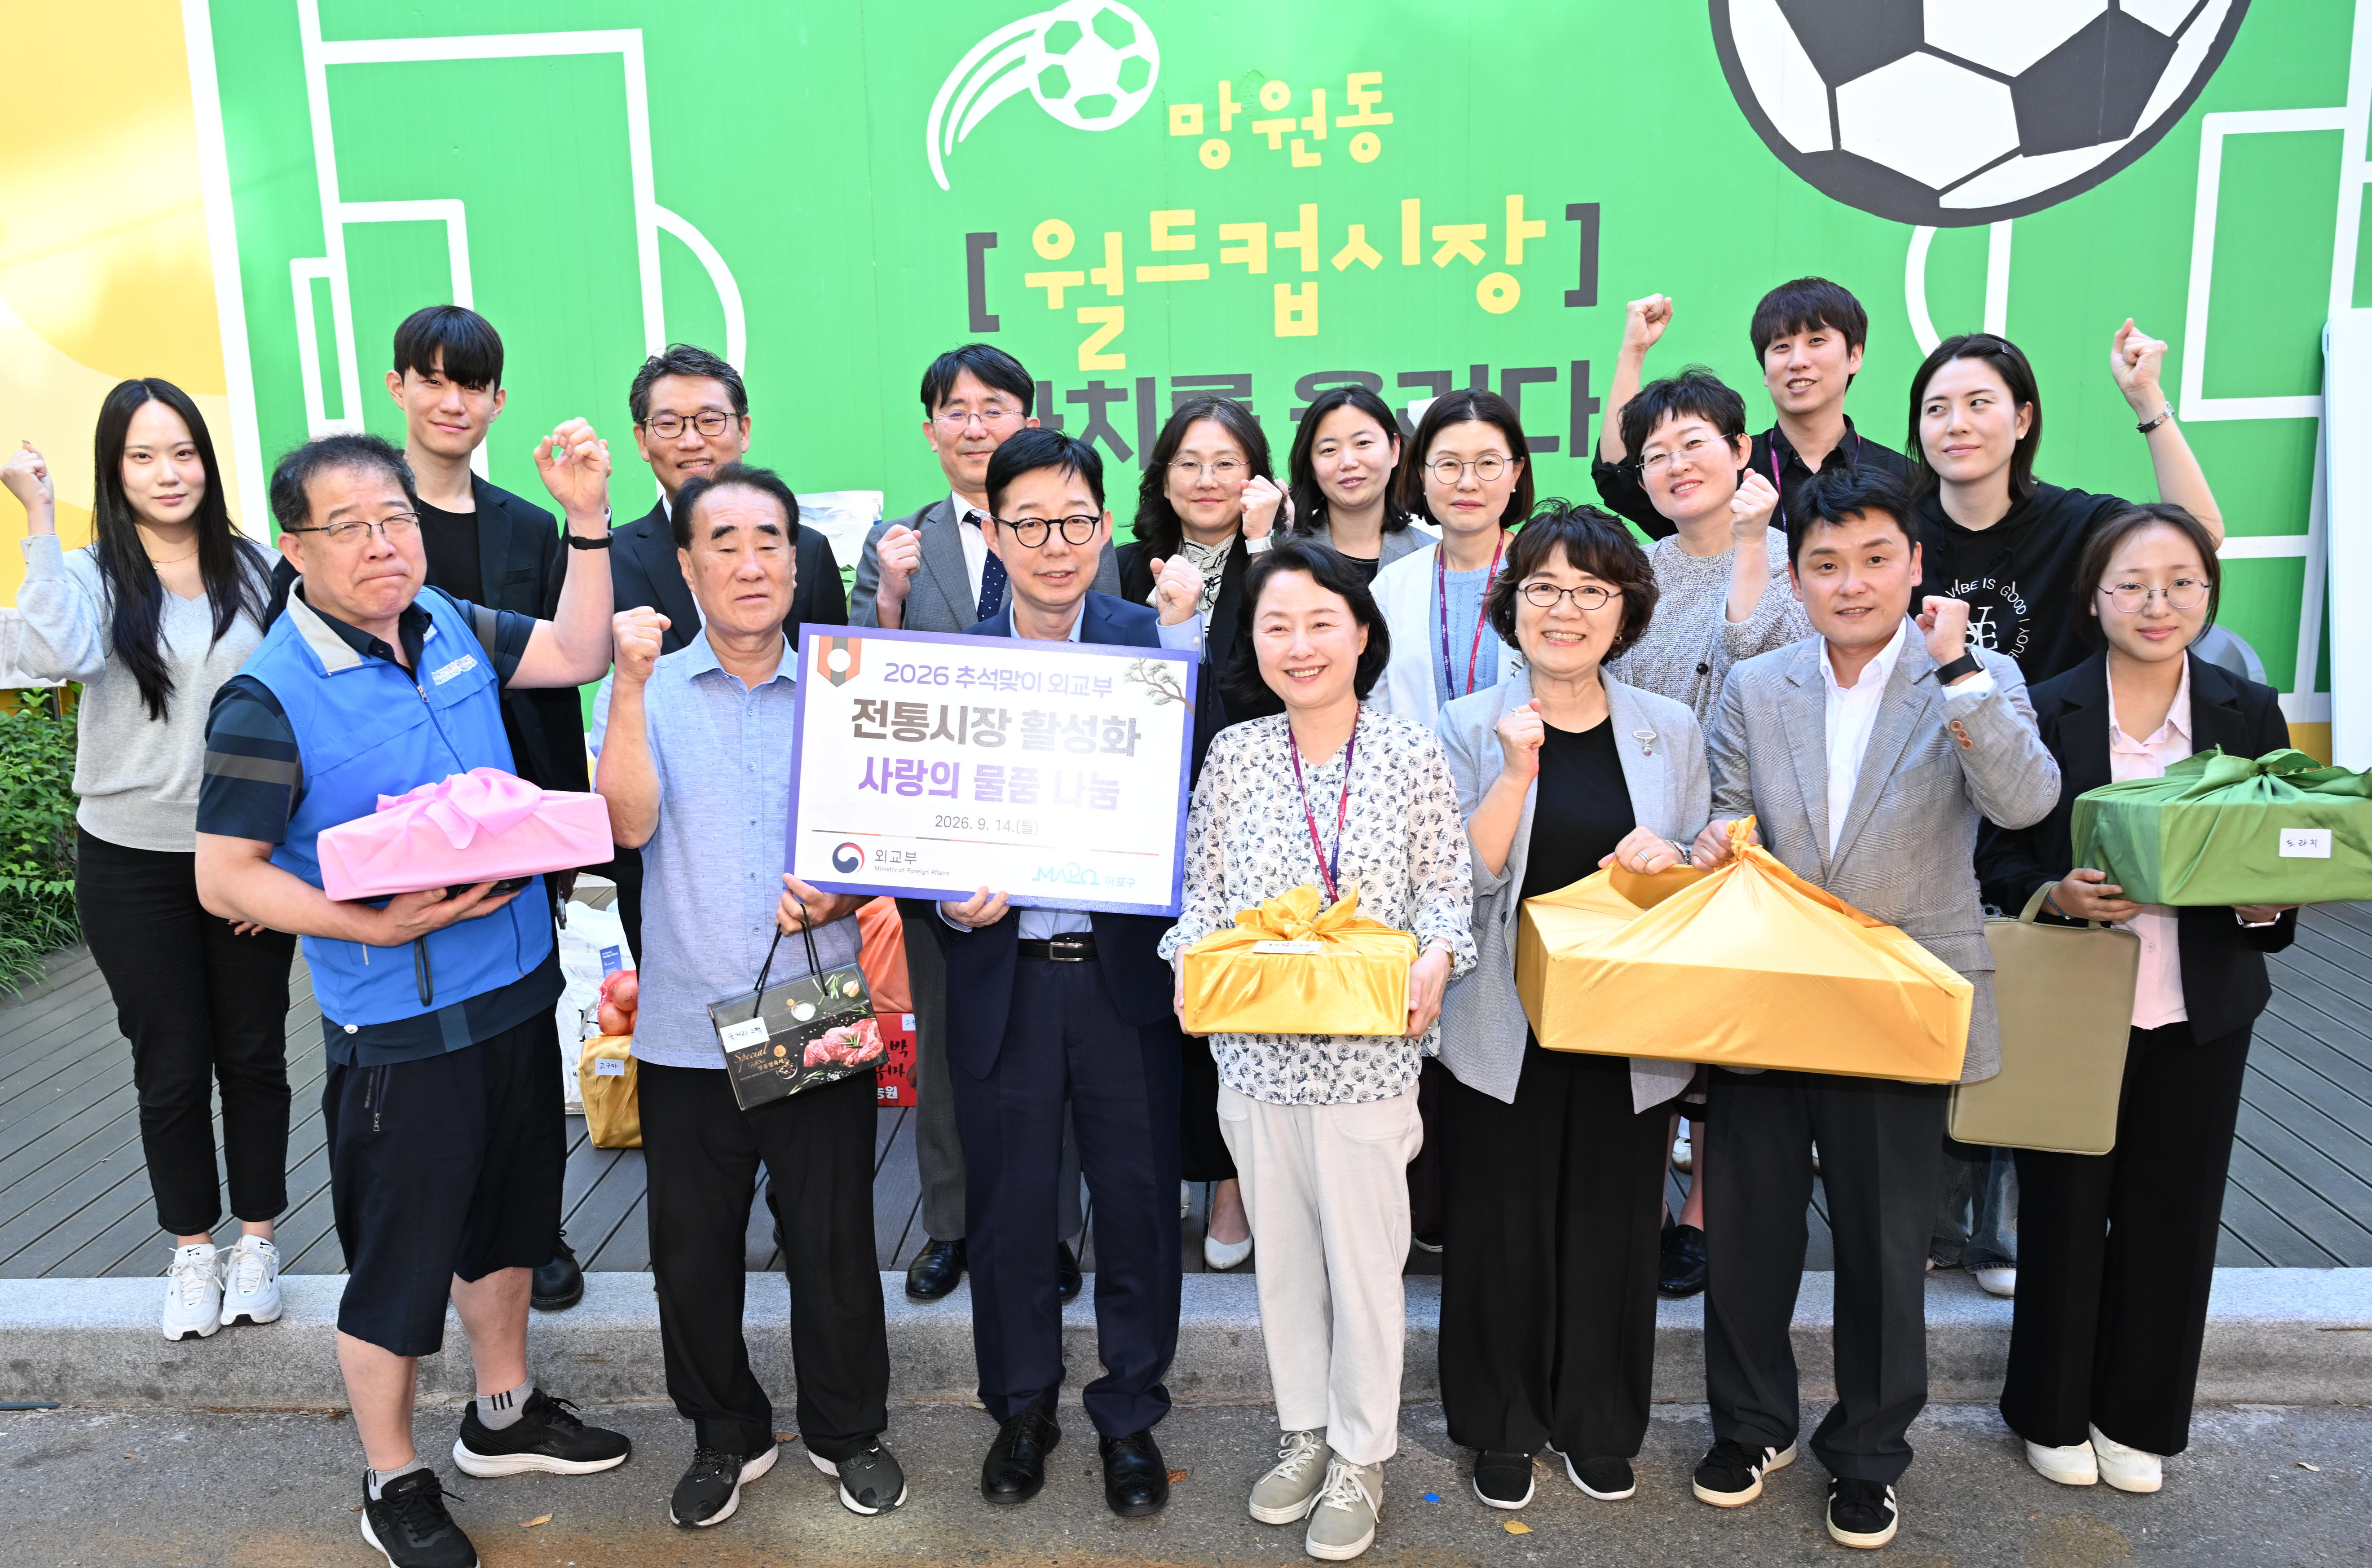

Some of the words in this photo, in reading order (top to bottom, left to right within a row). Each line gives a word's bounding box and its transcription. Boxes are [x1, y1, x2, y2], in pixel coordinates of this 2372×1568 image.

[1169, 71, 1394, 170] 망원동
[1025, 194, 1546, 371] 월드컵시장
[1945, 580, 1979, 598] VIBE
[1982, 578, 1996, 590] IS
[2000, 586, 2026, 615] GOOD
[884, 662, 950, 686] 2026
[955, 665, 1042, 693] 추석맞이
[1047, 673, 1112, 698] 외교부
[851, 698, 1012, 747] 전통시장
[1020, 709, 1142, 757] 활성화
[858, 756, 960, 799] 사랑의
[973, 764, 1040, 805] 물품
[1053, 770, 1120, 811] 나눔
[935, 815, 973, 830] 2026.
[978, 818, 989, 831] 9.
[875, 850, 917, 865] 외교부
[2286, 839, 2318, 848] 도라지
[1105, 876, 1136, 888] 마포구
[733, 1040, 770, 1073] Special
[888, 1039, 908, 1058] 박
